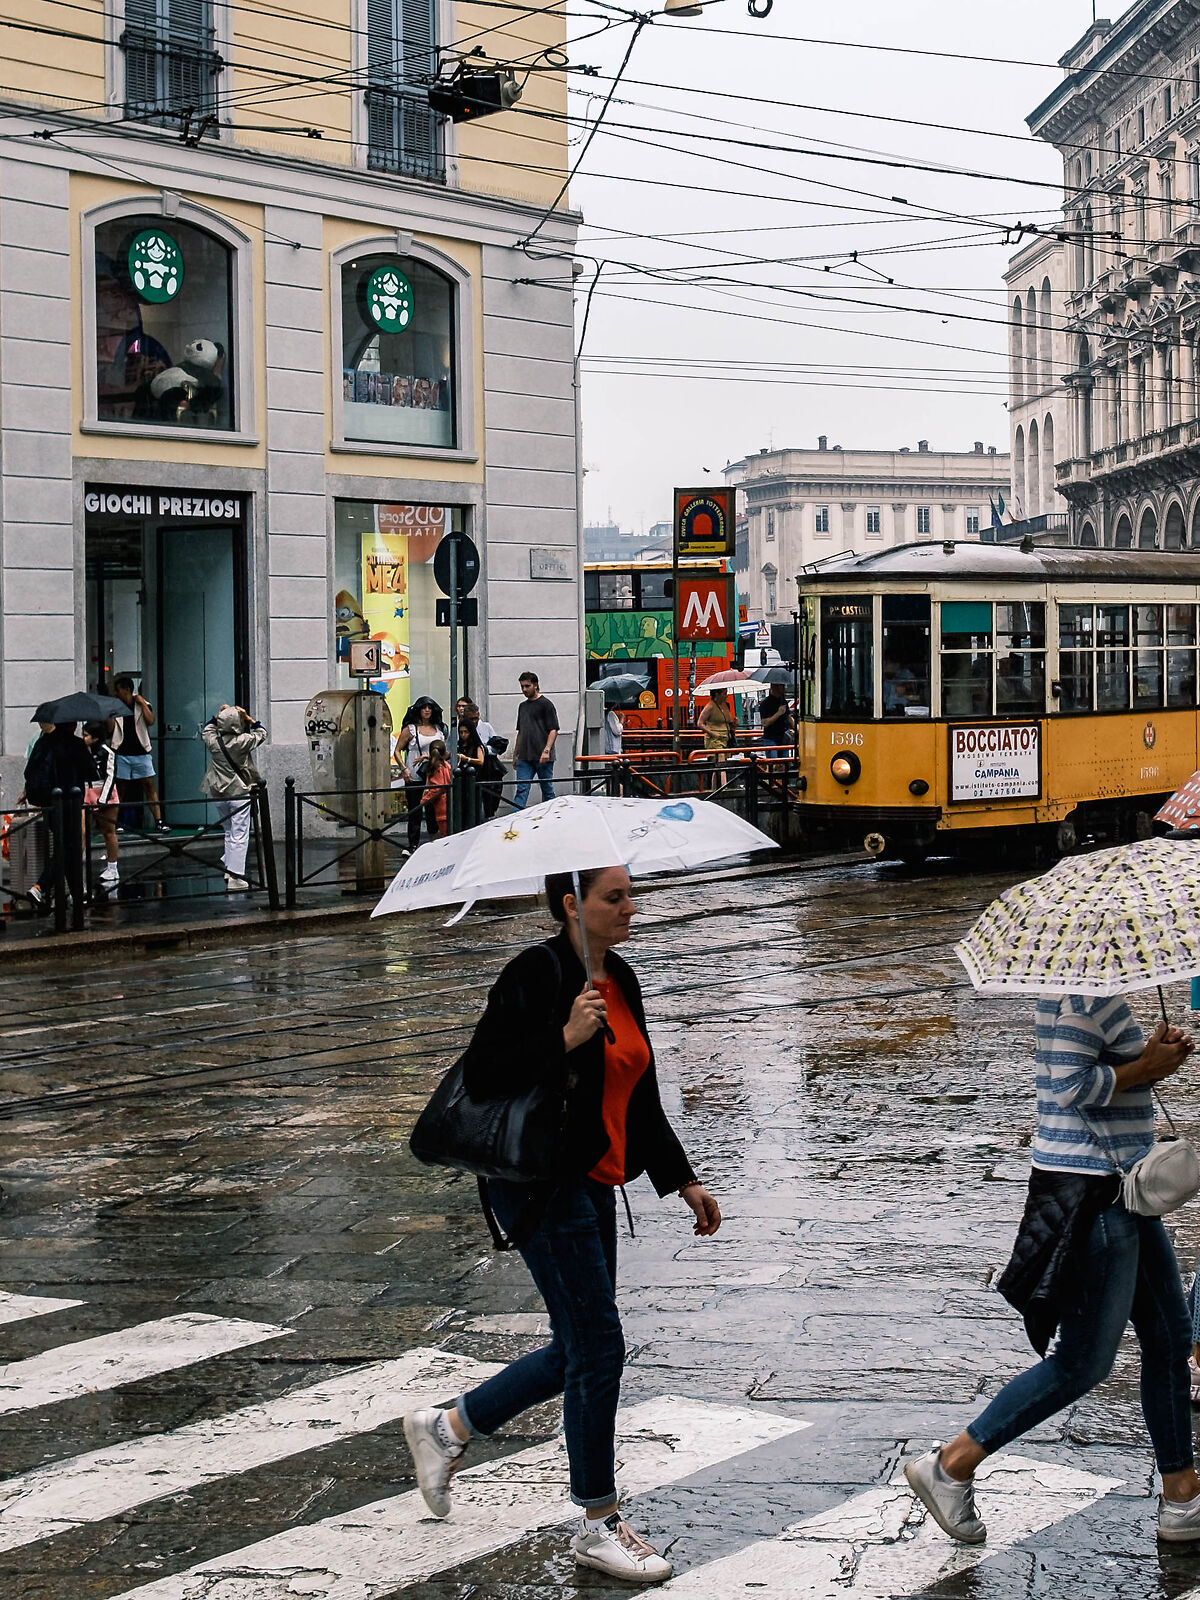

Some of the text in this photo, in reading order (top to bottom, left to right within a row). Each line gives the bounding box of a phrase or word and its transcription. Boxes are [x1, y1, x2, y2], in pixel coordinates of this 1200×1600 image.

[84, 493, 241, 518] GIOCHI PREZIOSI
[682, 591, 725, 628] M
[831, 731, 864, 746] 1596
[956, 728, 1038, 753] BOCCIATO?
[974, 767, 1020, 779] CAMPANIA
[973, 789, 984, 797] 02
